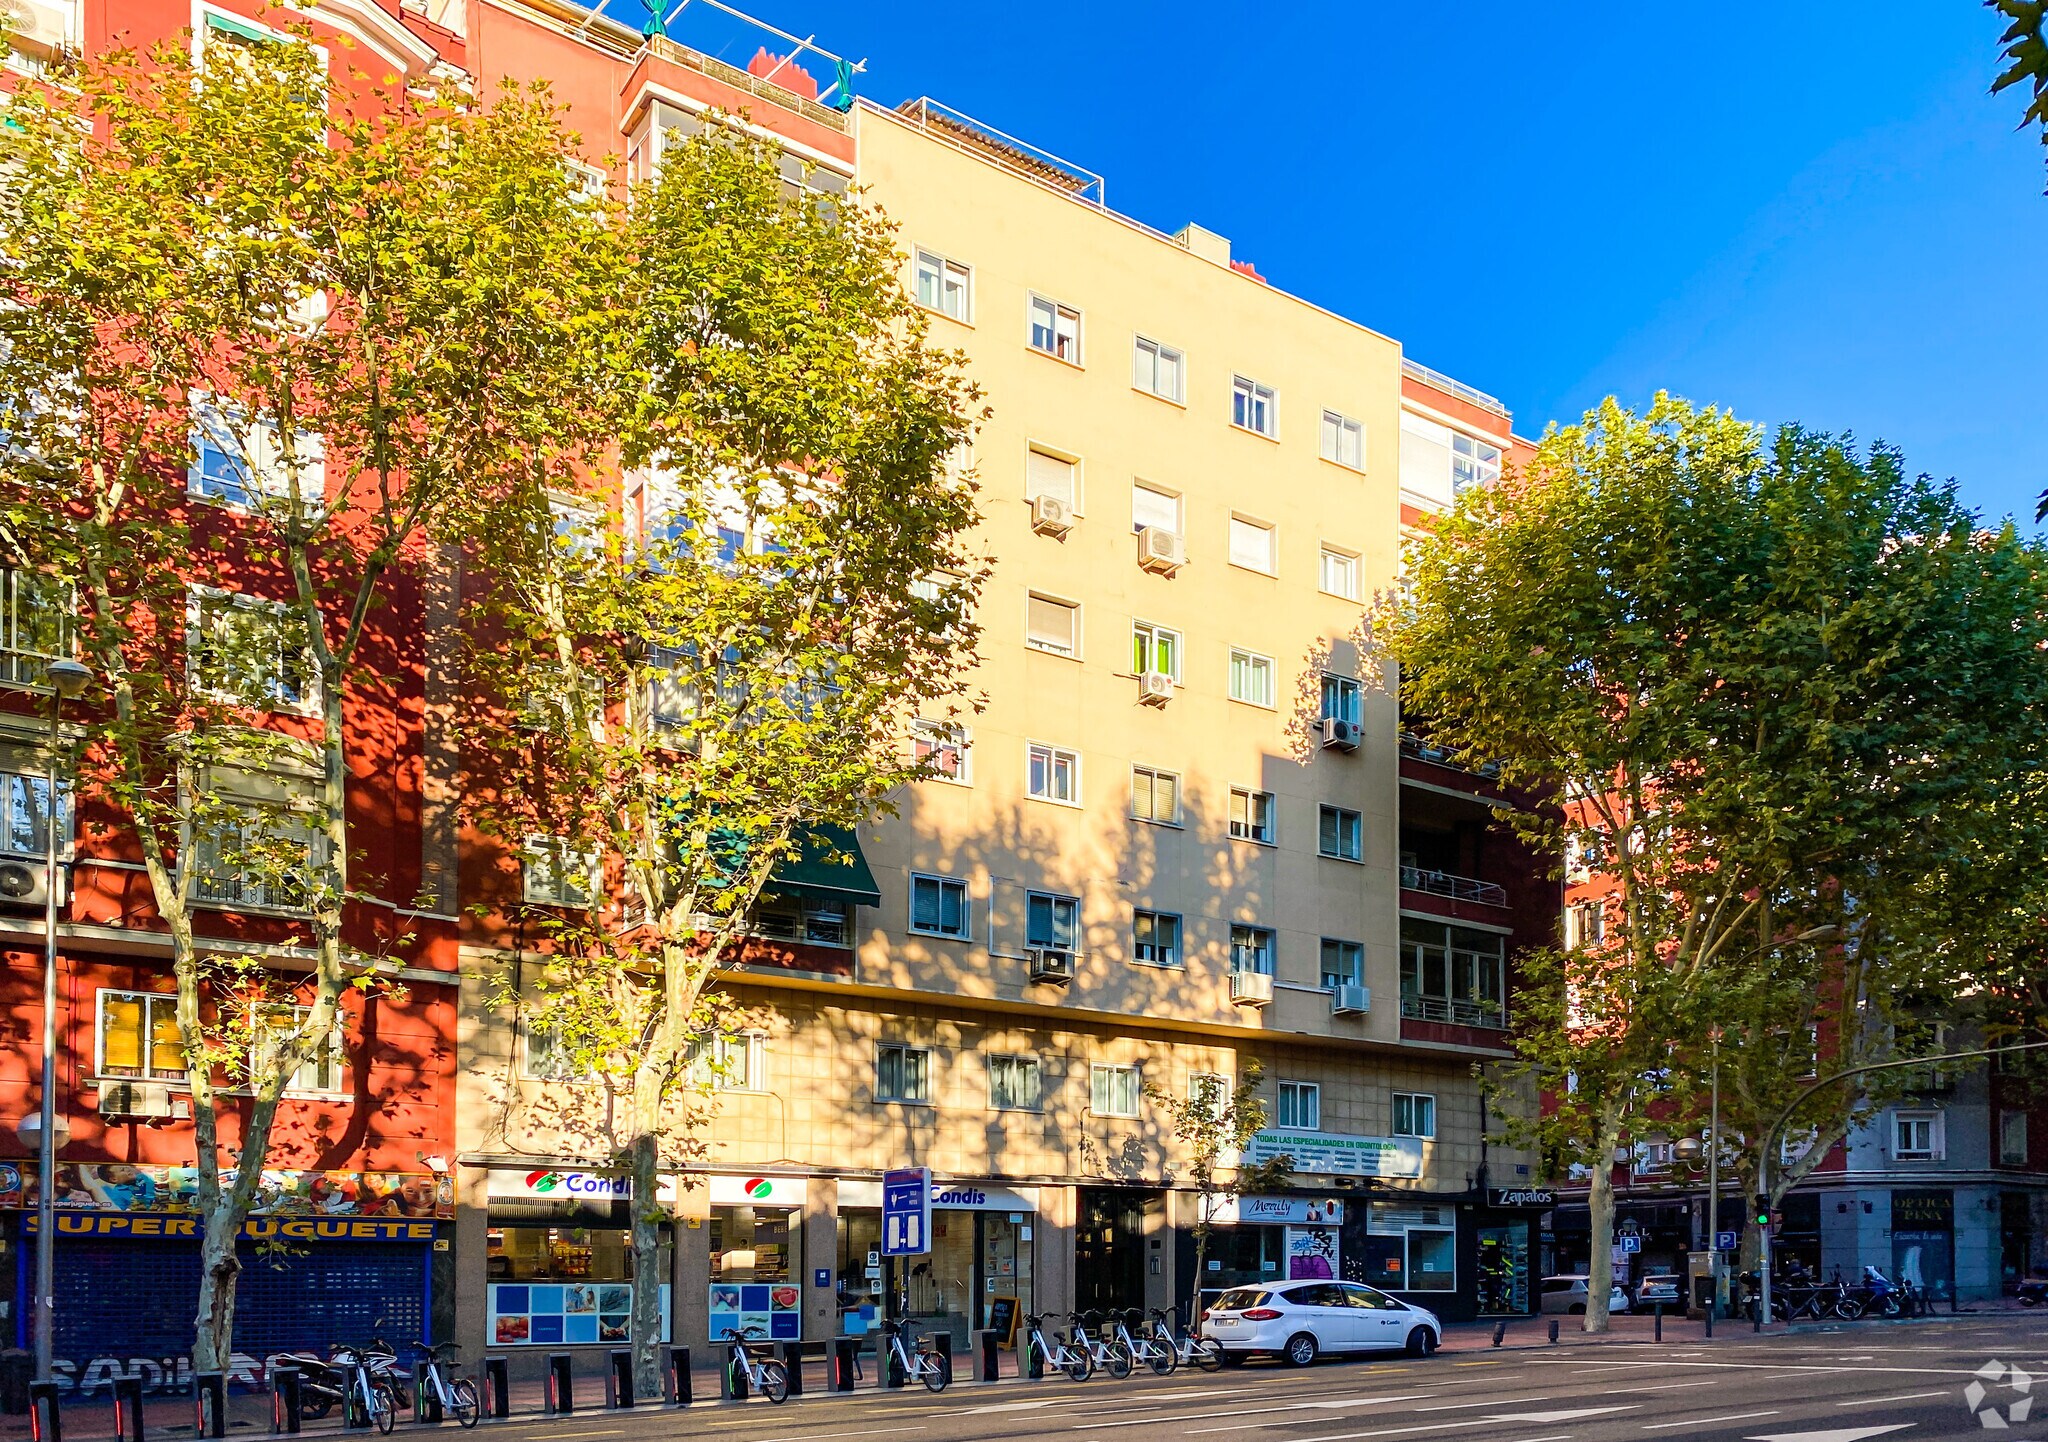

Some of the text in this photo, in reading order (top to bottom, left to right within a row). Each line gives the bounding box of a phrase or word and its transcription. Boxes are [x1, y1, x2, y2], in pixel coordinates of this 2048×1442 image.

[1256, 1135, 1277, 1143] TODAS
[1293, 1137, 1344, 1148] ESPECIALIDADES
[1356, 1141, 1397, 1150] ODONTOLOGÍA
[566, 1174, 629, 1194] Condi
[1499, 1189, 1552, 1206] Zapatos
[236, 1220, 434, 1238] UGUETE
[1624, 1238, 1634, 1251] P
[1720, 1234, 1731, 1247] P
